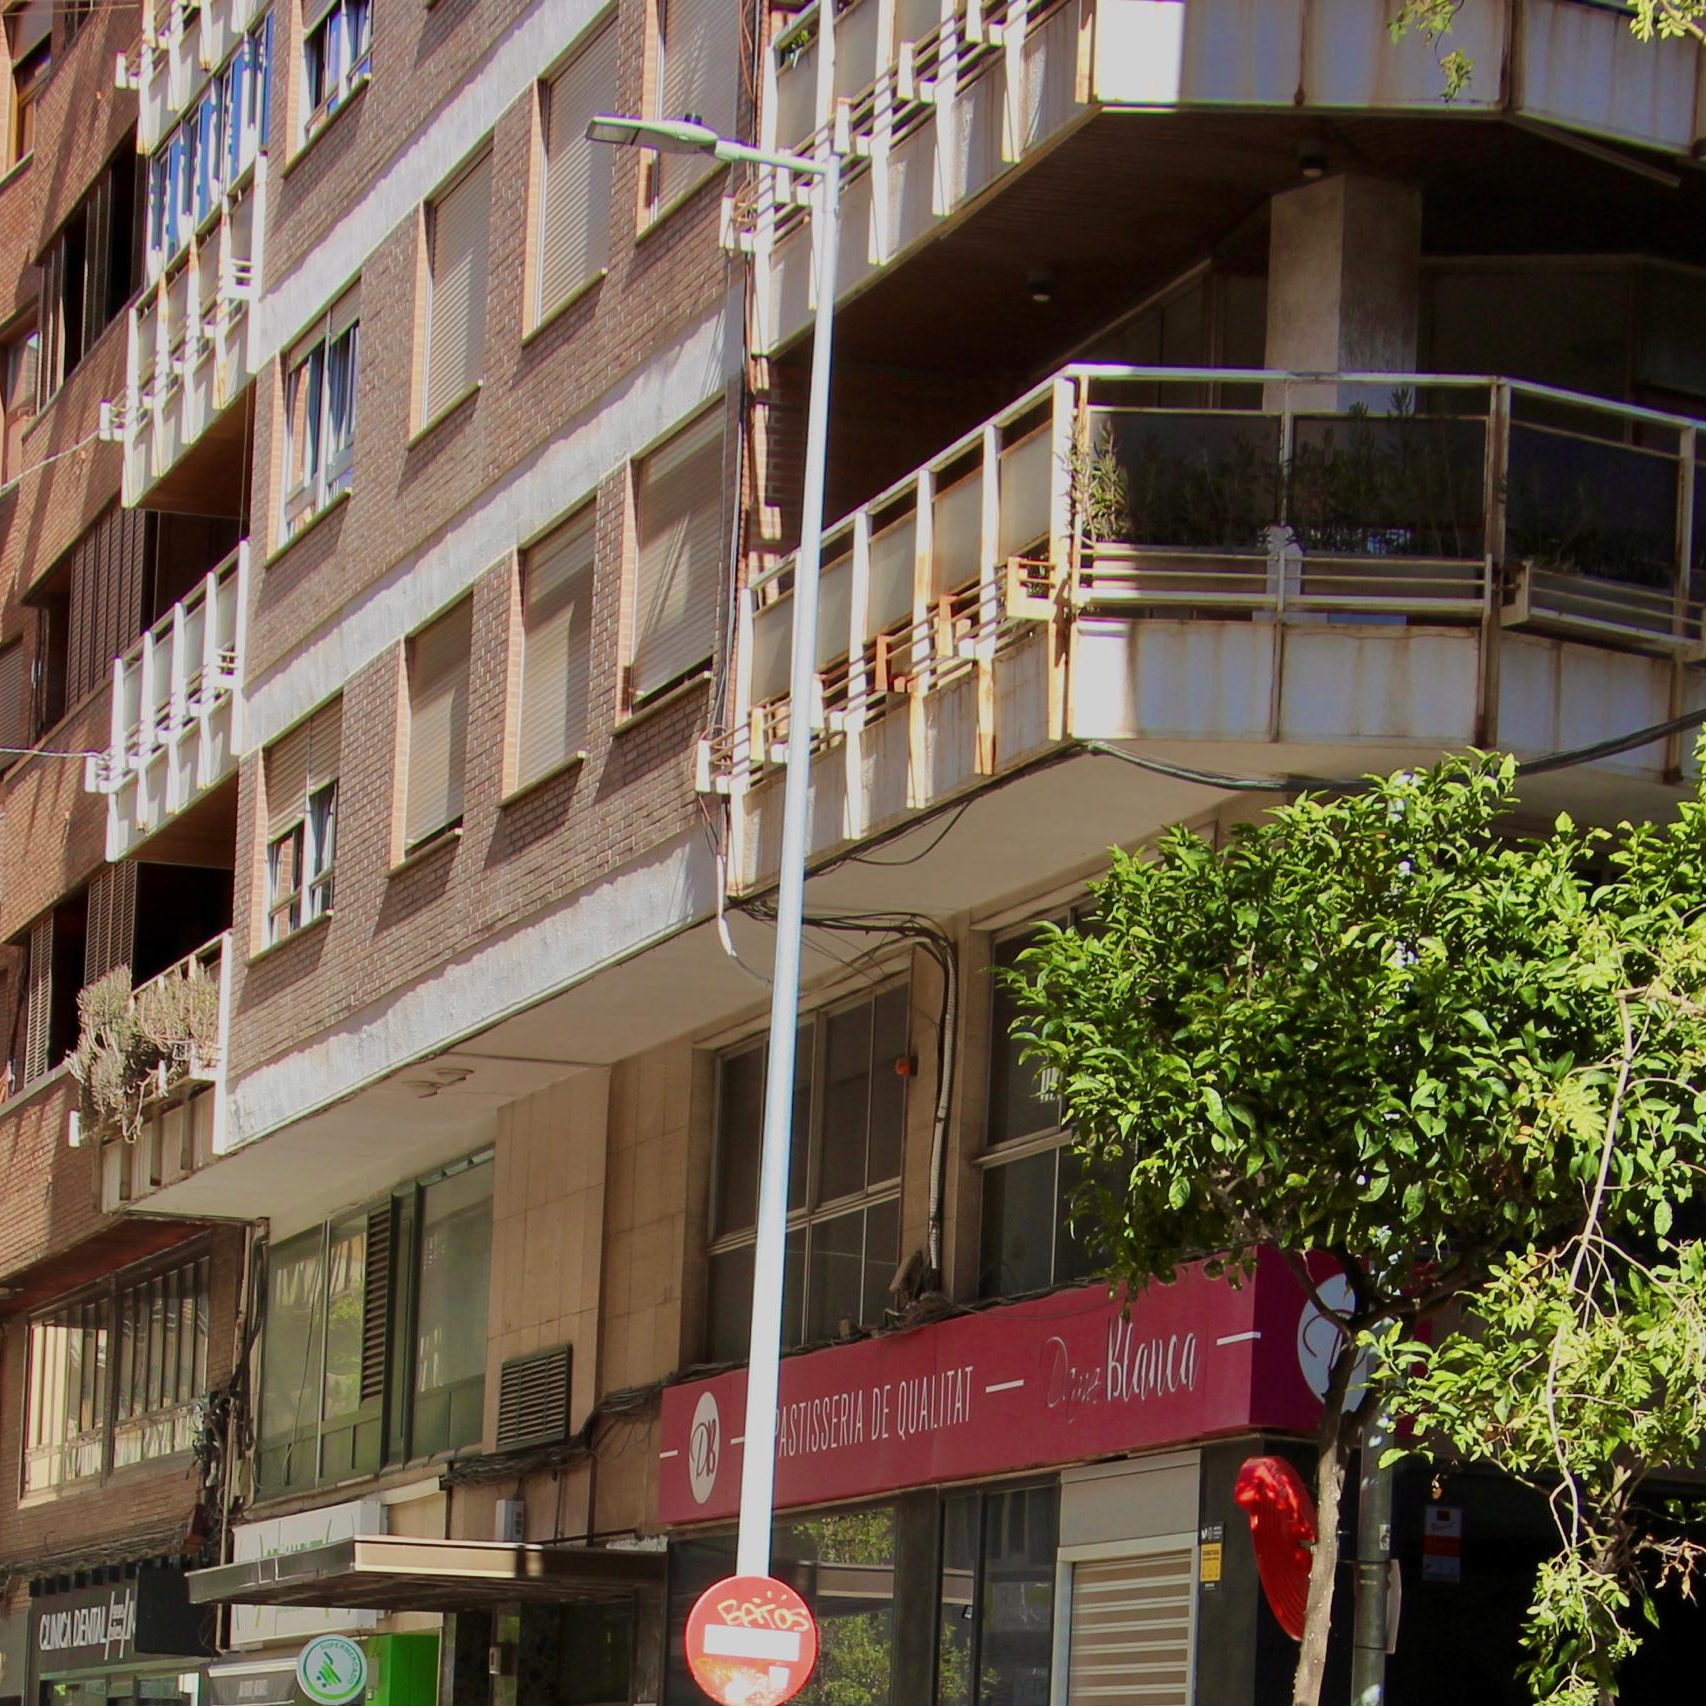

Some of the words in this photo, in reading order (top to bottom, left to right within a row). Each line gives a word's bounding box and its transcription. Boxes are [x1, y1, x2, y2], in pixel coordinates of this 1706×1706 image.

[1106, 1317, 1197, 1401] Blanca
[870, 1385, 892, 1440] DE
[896, 1366, 974, 1440] QUALITAT
[39, 1611, 72, 1651] CLINICA
[73, 1605, 107, 1647] DENTAL
[319, 1642, 359, 1685] SUPERMERCADO
